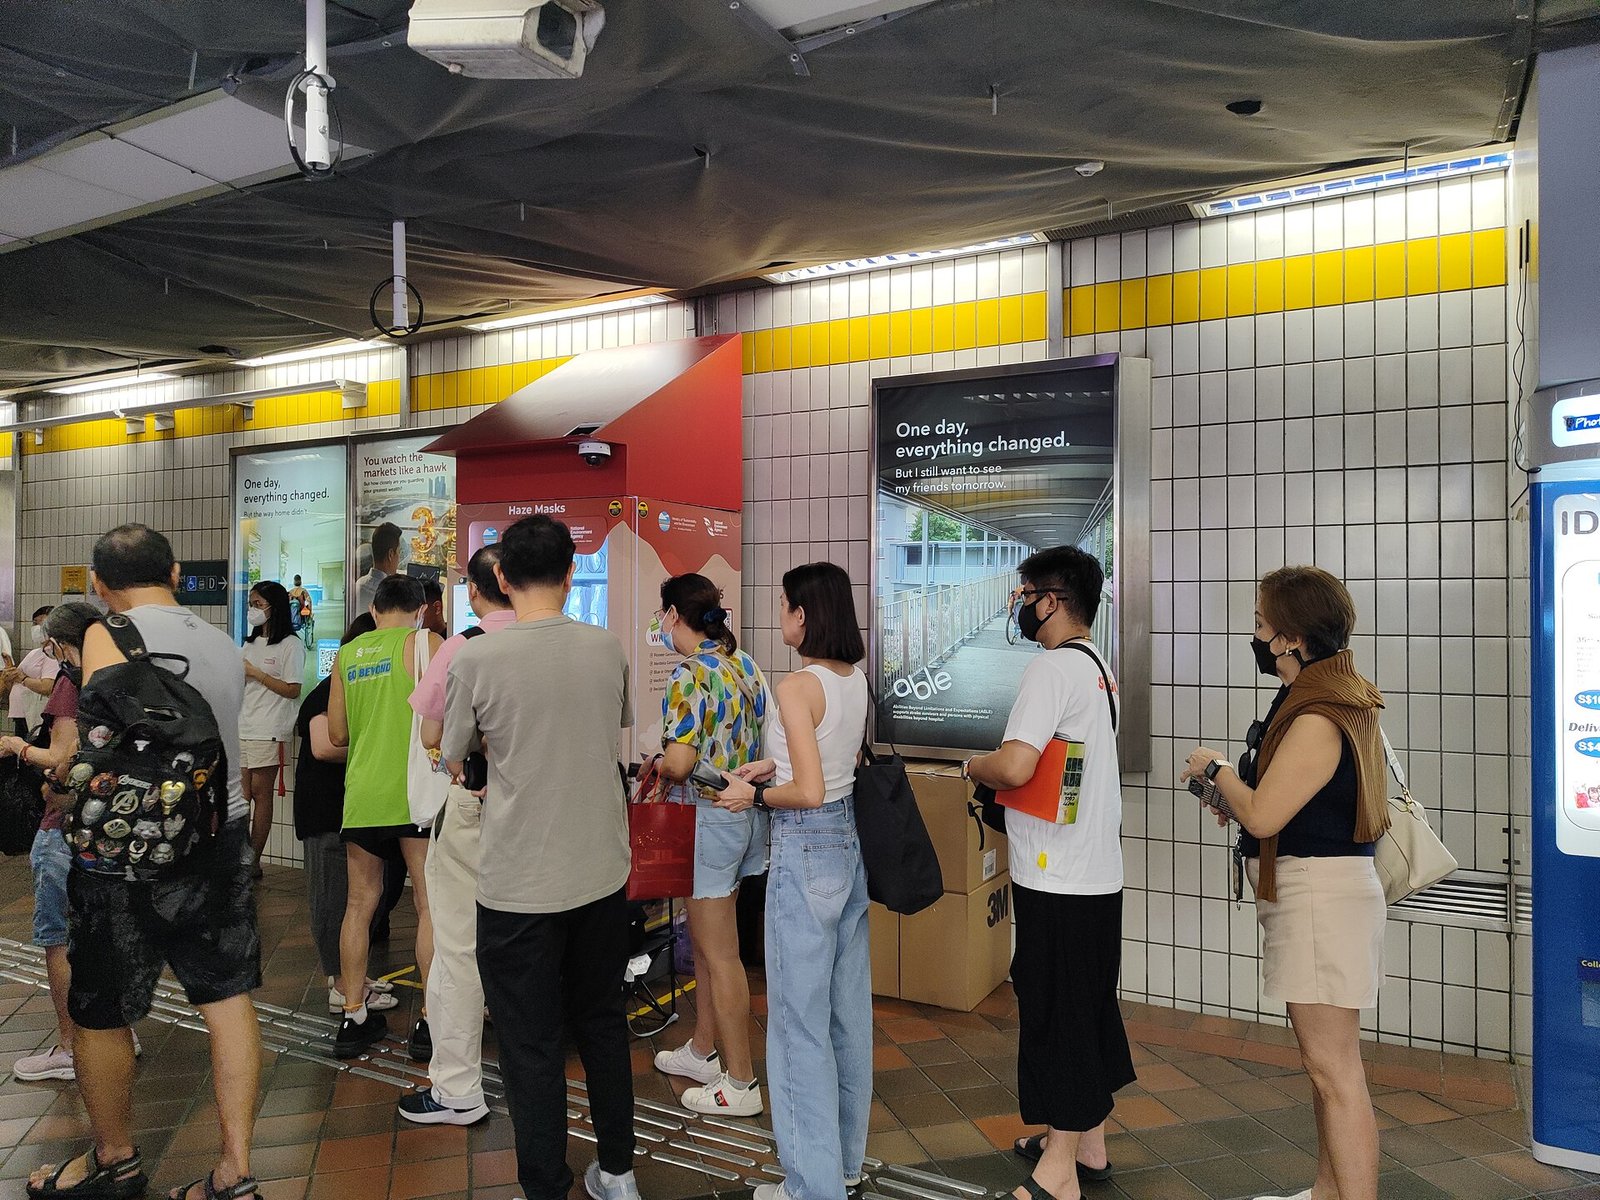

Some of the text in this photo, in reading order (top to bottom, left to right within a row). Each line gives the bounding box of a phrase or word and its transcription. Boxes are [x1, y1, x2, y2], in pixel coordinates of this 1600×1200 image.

[896, 418, 969, 438] One day,
[895, 430, 1071, 460] everything changed.
[363, 452, 423, 467] You watch the
[363, 461, 447, 478] markets like a hawk
[895, 465, 1002, 479] But I still want to see
[244, 477, 281, 490] One day,
[895, 480, 1007, 496] my friends tomorrow.
[243, 487, 330, 505] everything changed.
[243, 511, 253, 519] But
[263, 511, 274, 519] way
[275, 509, 290, 517] home
[508, 503, 566, 515] Haze Masks
[1561, 510, 1599, 536] ID
[208, 577, 215, 589] D
[347, 670, 357, 681] GO
[358, 662, 392, 678] BEYOND
[893, 666, 952, 701] able
[1568, 722, 1600, 733] Deliv
[986, 883, 1009, 928] 3M
